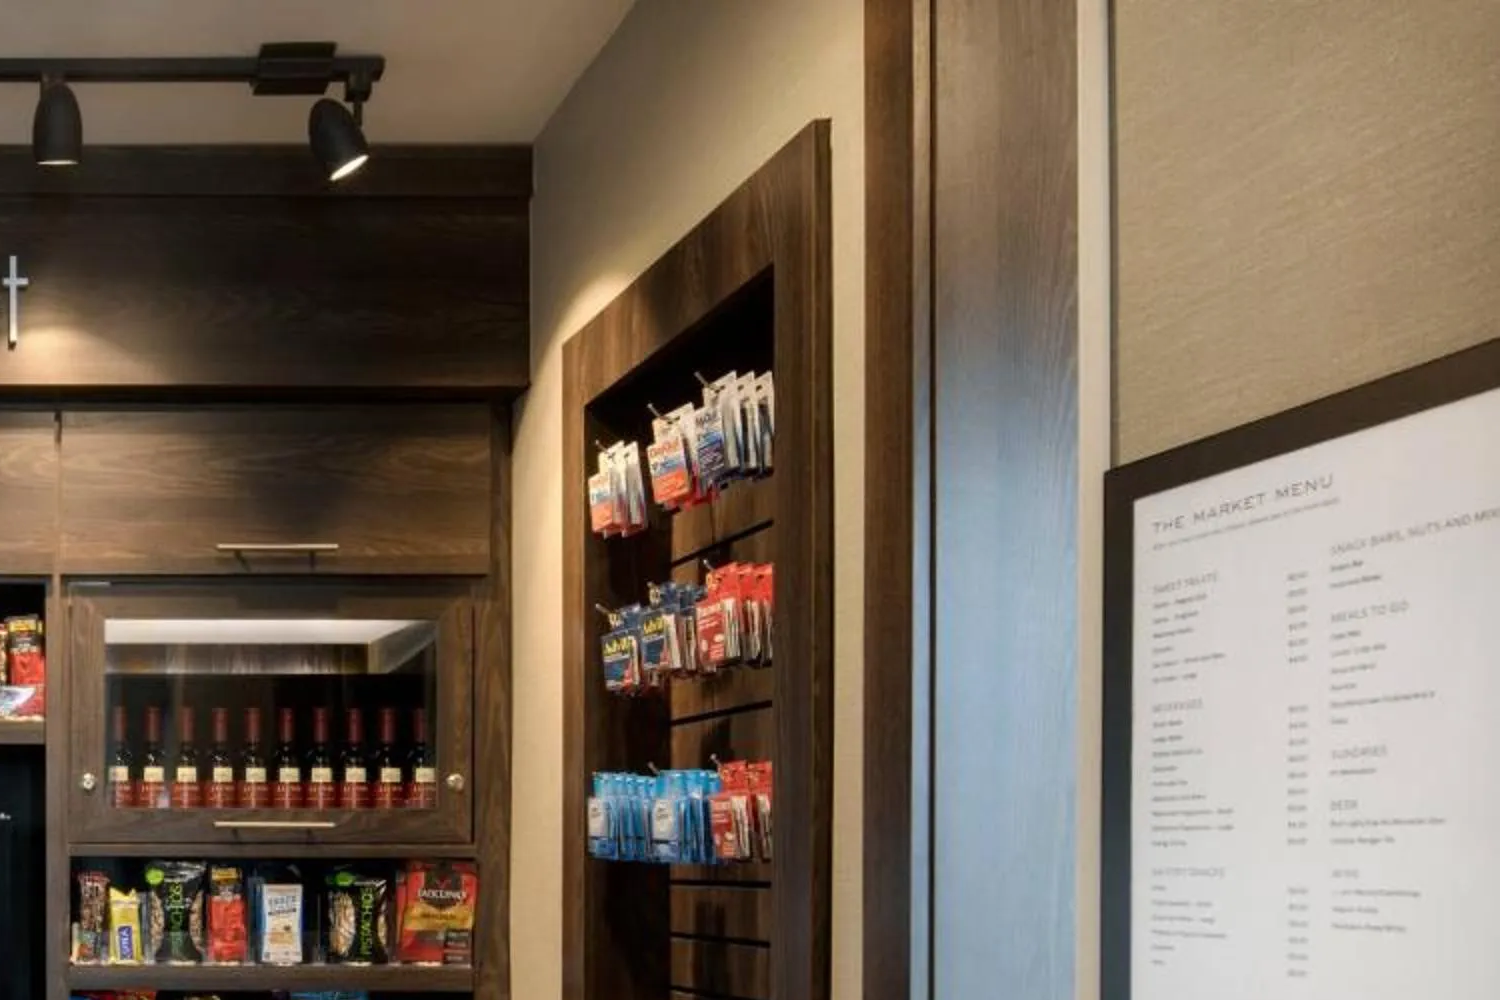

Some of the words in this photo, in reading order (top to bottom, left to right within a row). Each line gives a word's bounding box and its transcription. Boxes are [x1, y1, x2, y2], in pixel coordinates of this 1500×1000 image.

[1153, 515, 1186, 533] THE
[1192, 491, 1267, 525] MARKET
[1274, 473, 1334, 500] MENU
